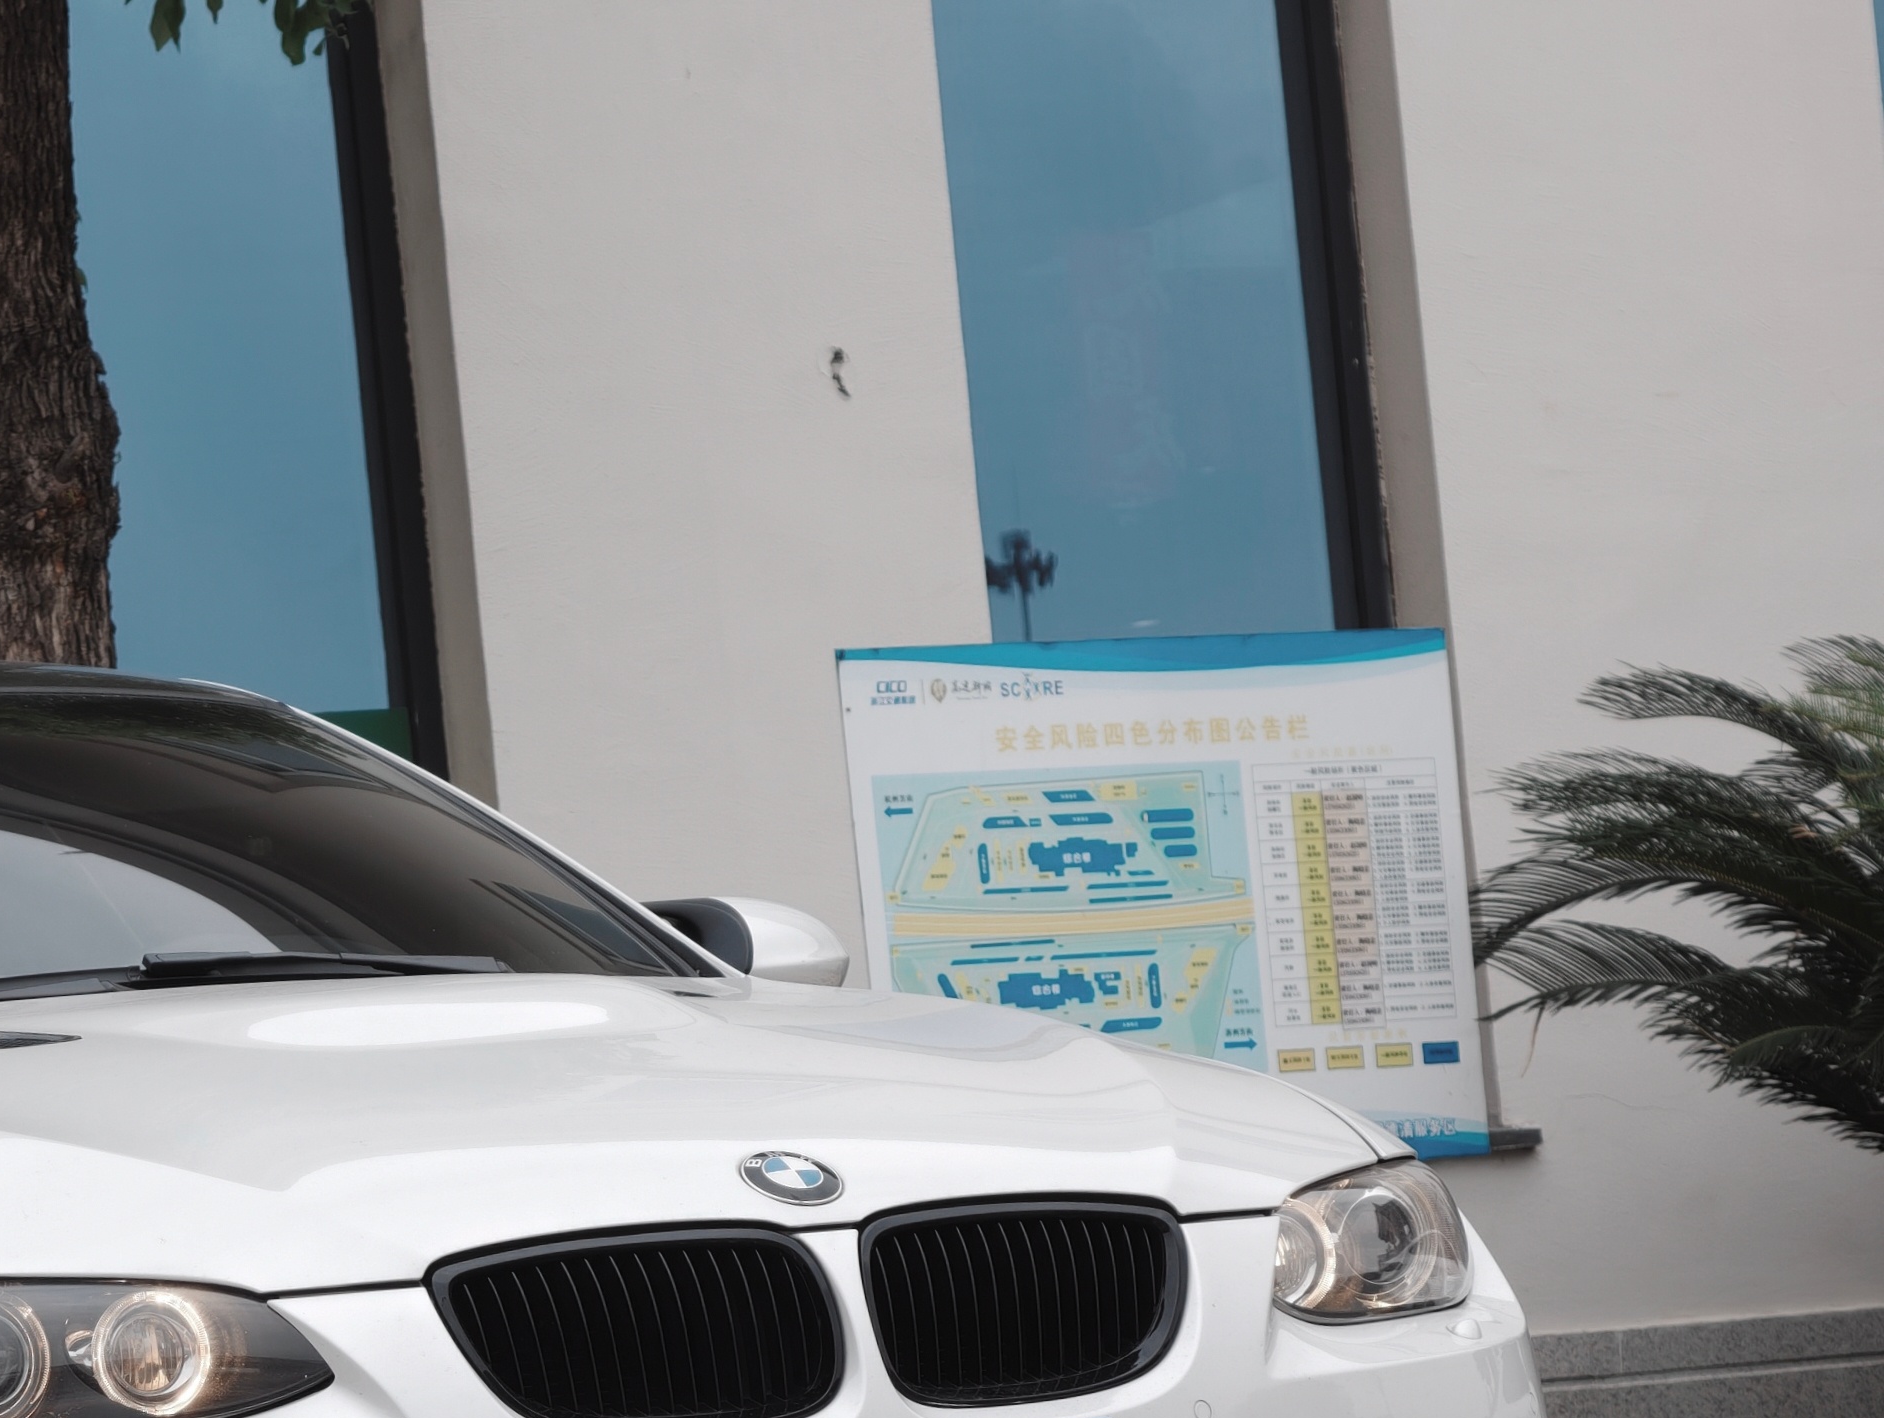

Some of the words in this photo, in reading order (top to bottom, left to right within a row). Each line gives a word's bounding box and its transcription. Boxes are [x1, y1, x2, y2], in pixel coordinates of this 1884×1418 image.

[995, 714, 1311, 753] 安全风险四色分布图公告栏
